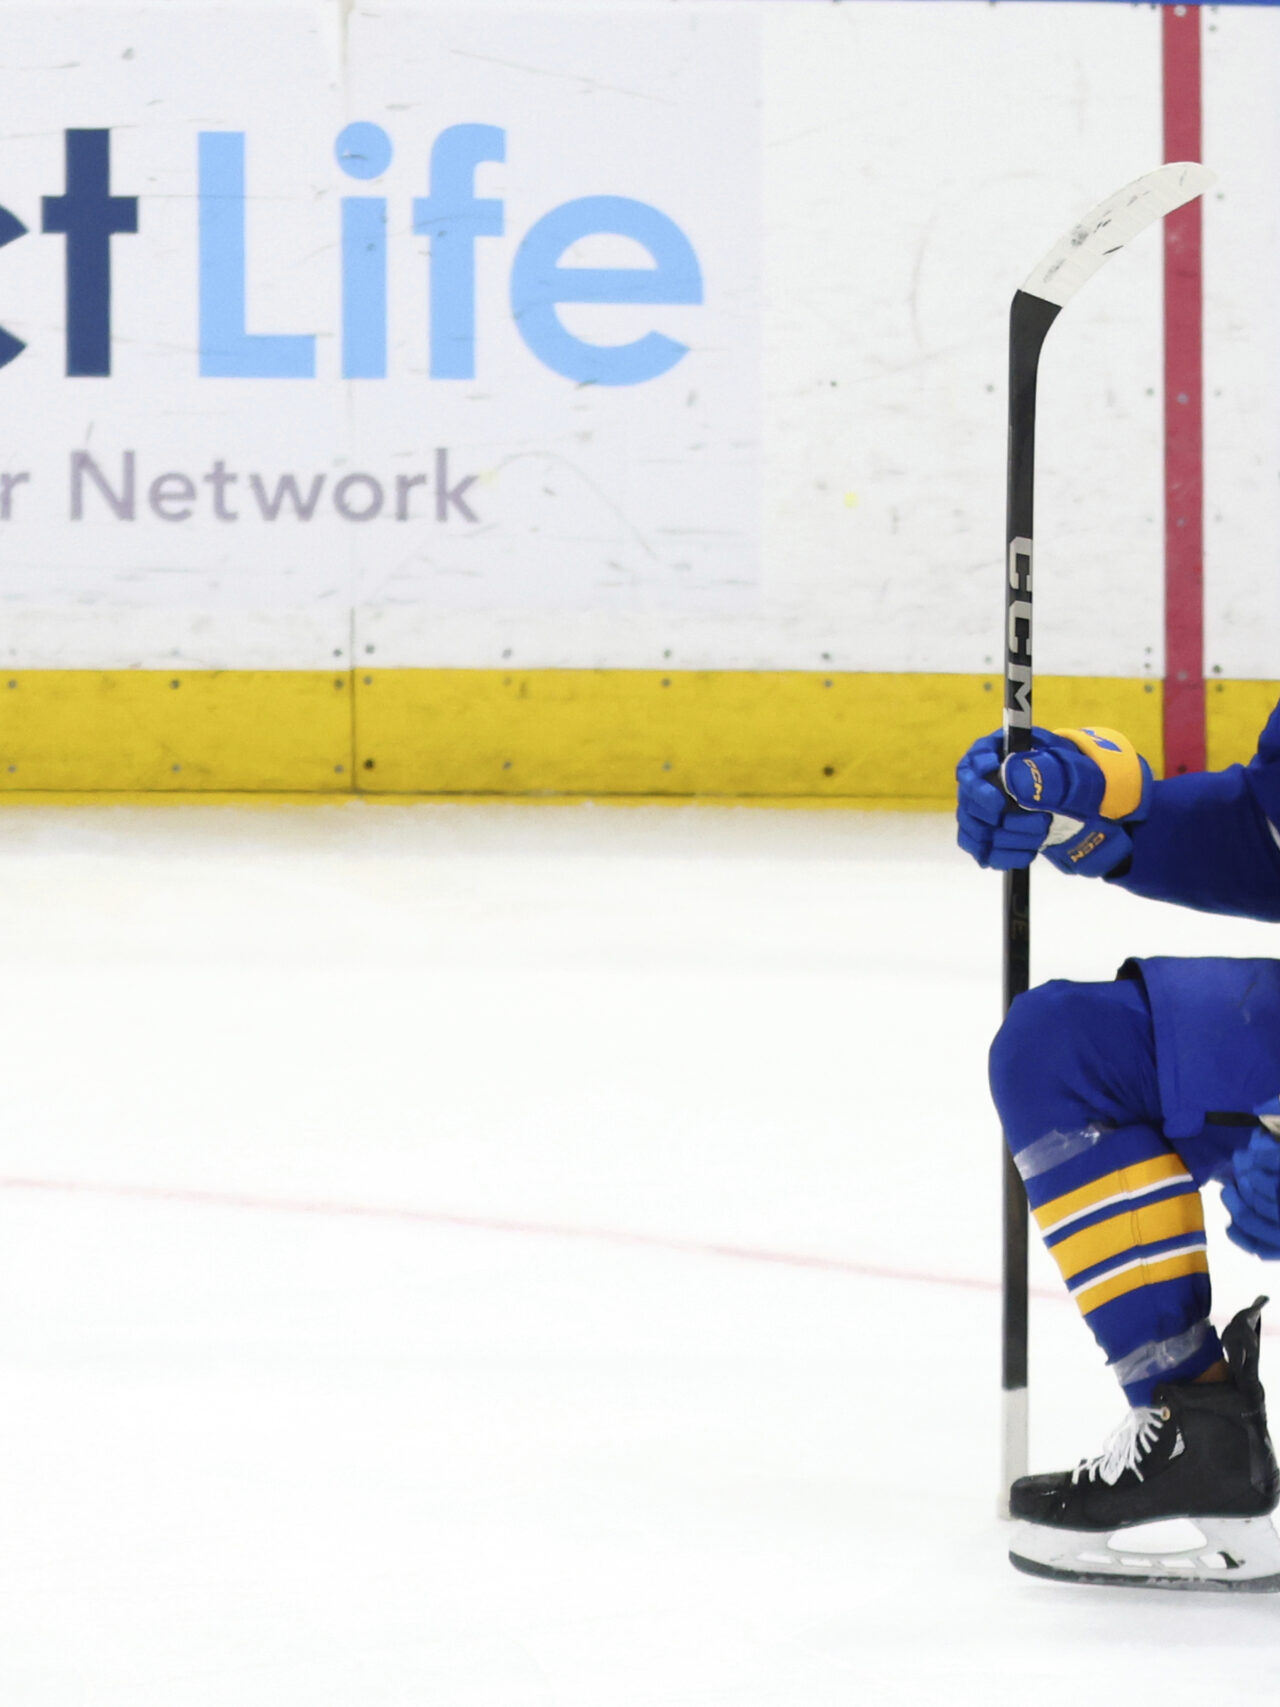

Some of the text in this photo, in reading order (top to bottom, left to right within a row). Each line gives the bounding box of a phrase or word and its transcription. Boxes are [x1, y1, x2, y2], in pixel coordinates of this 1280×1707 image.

[198, 121, 704, 387] Life
[69, 448, 481, 523] Network
[1008, 536, 1033, 729] CCM
